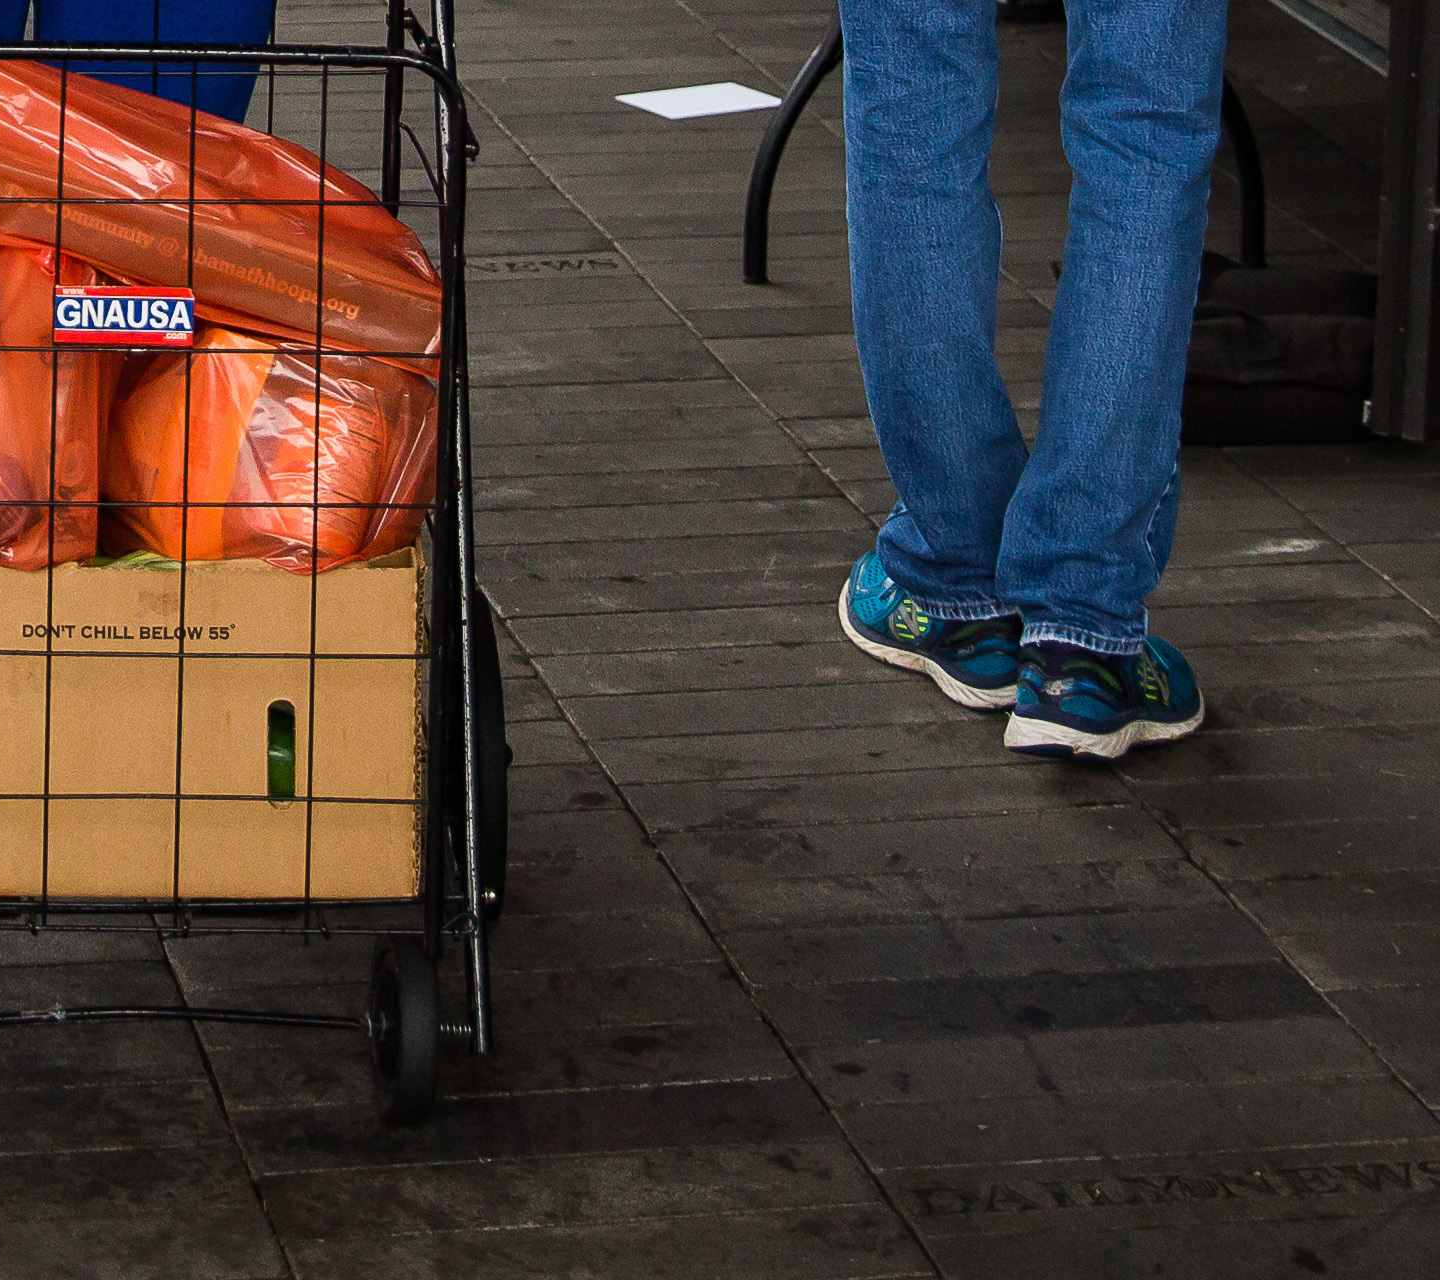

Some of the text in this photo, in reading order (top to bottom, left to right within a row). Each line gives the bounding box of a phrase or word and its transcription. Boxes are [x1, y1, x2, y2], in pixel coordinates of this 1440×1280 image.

[56, 298, 193, 330] GNAUSA
[163, 331, 188, 341] .com
[22, 624, 76, 639] DON'T
[80, 625, 135, 640] CHILL
[139, 626, 204, 641] BELOW
